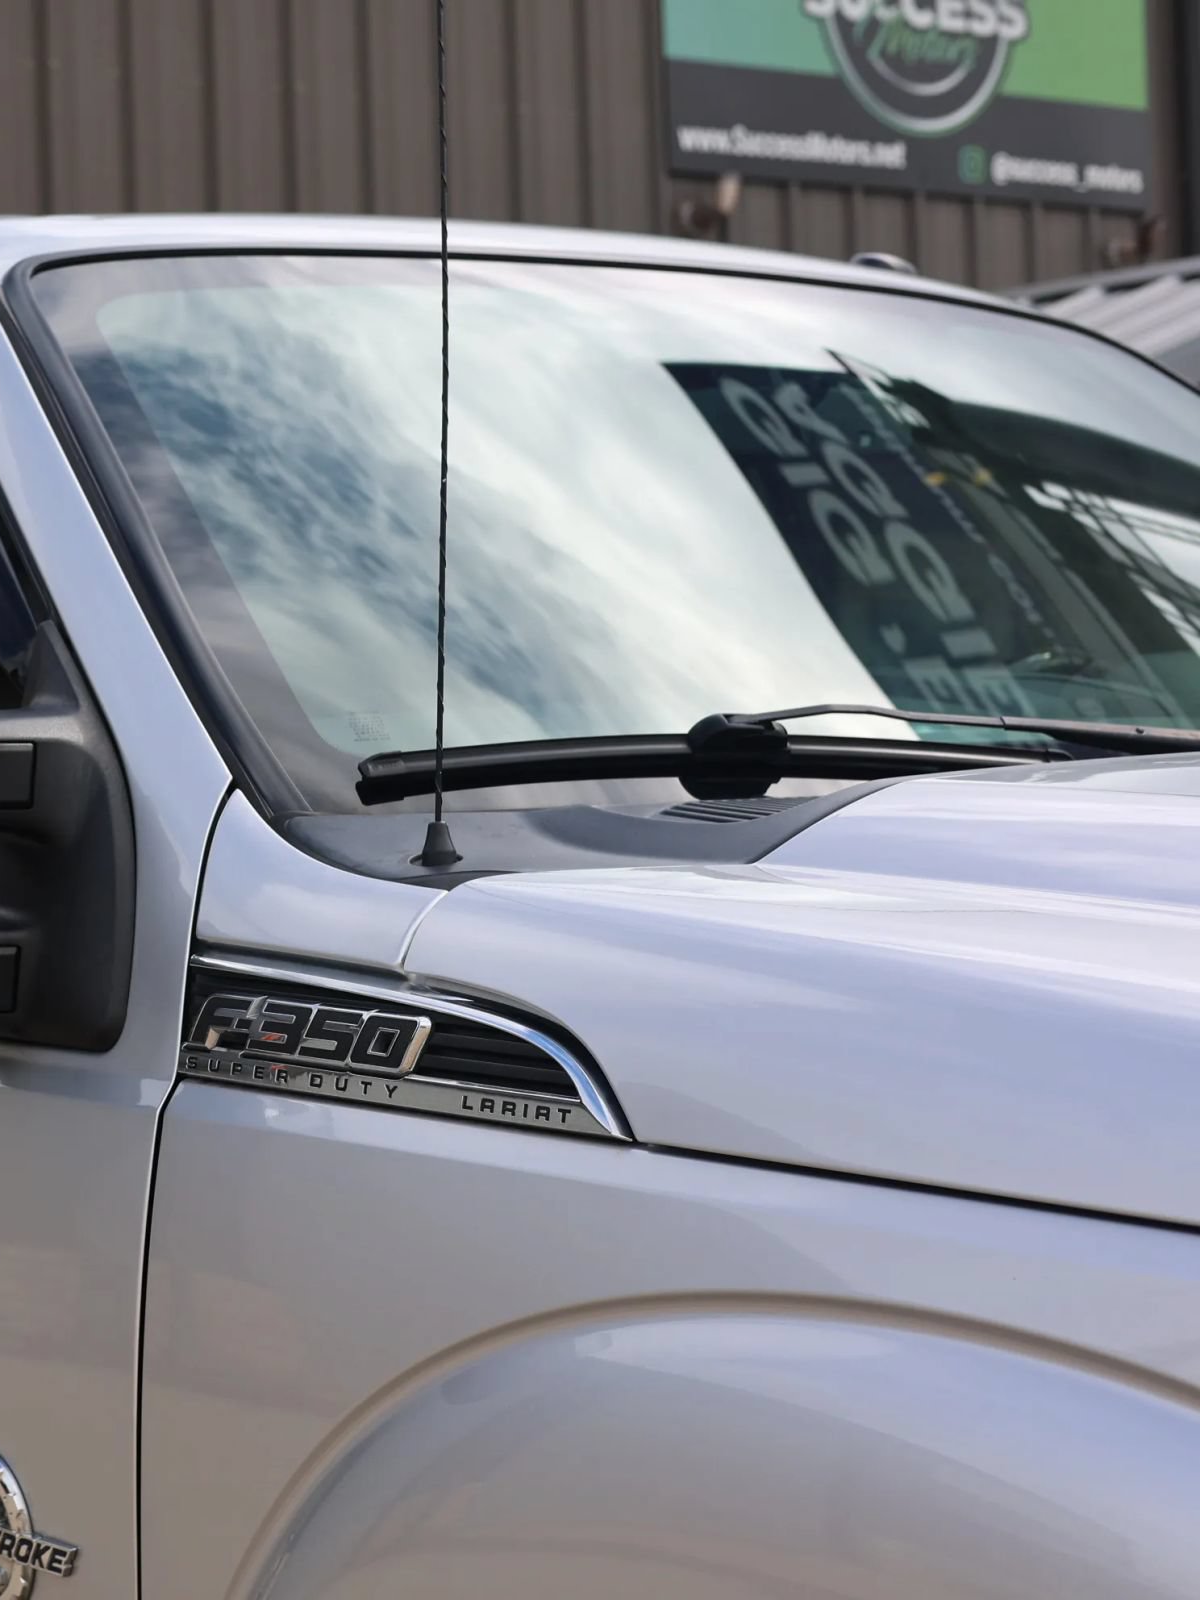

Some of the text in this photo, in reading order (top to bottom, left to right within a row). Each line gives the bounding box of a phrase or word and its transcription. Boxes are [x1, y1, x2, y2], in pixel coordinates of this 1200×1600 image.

[189, 993, 432, 1079] F-350
[185, 1056, 399, 1099] SUPER DUTY
[461, 1095, 573, 1125] LARIAT
